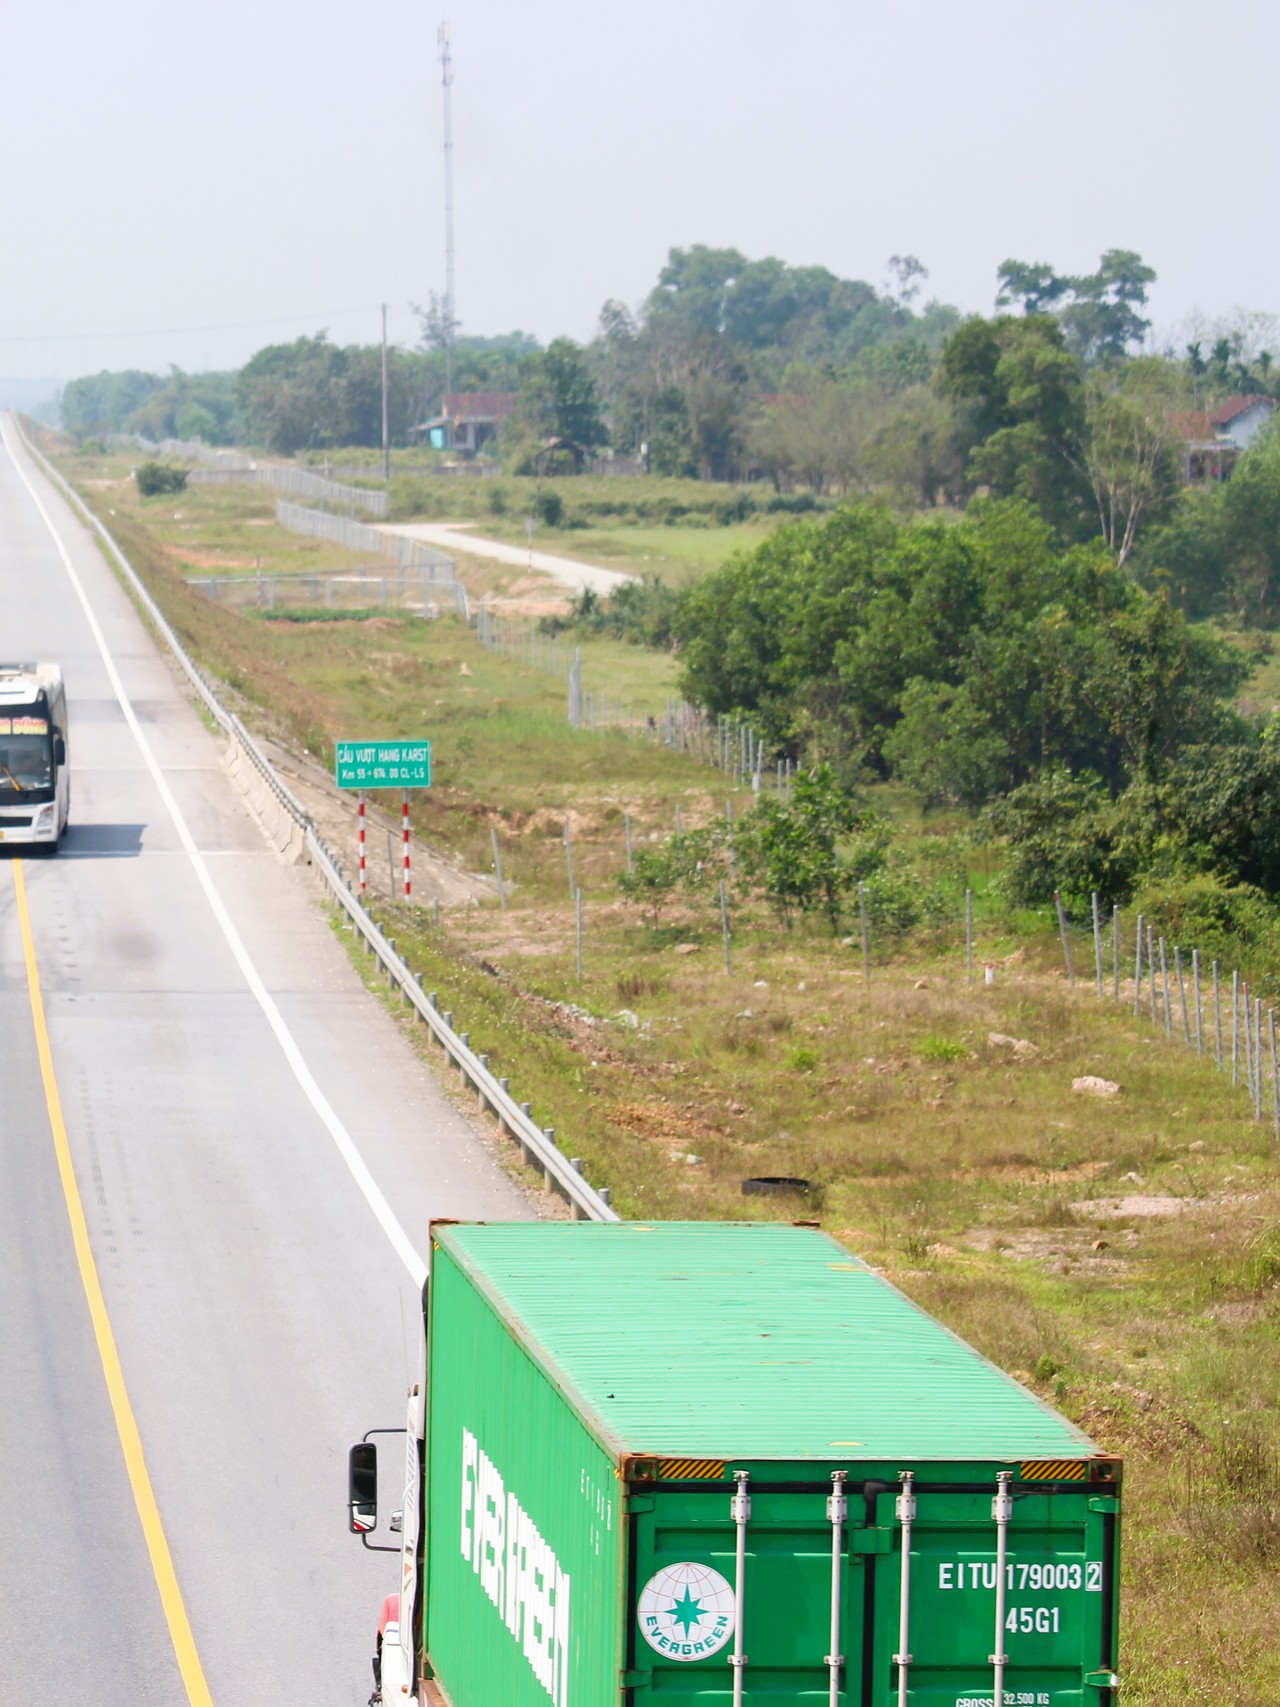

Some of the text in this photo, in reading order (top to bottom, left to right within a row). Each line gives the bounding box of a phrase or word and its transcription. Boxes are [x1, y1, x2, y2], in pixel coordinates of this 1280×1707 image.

[378, 748, 400, 762] HANG
[401, 748, 428, 762] KARST
[342, 769, 355, 779] Km
[938, 1562, 997, 1590] EITU
[1005, 1607, 1060, 1633] 45G1
[646, 1615, 729, 1655] EVERGREEN
[1037, 1692, 1050, 1705] KG
